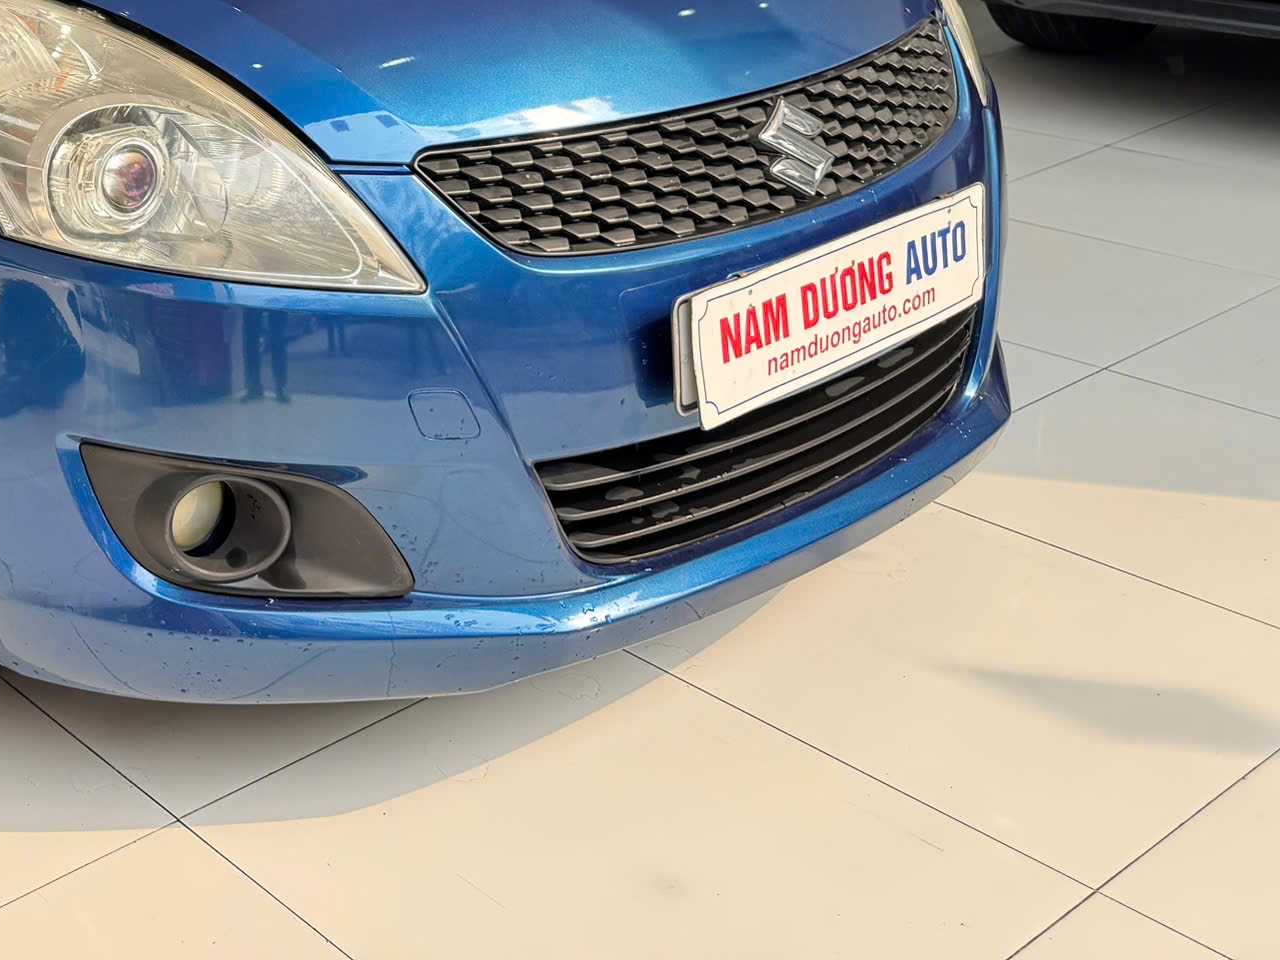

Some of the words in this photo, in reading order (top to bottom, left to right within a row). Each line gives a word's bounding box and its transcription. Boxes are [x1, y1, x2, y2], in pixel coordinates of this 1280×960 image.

[719, 293, 790, 364] NAM
[800, 251, 894, 330] DƯƠNG
[905, 220, 967, 285] AUTO
[767, 286, 937, 376] namduongauto.com
